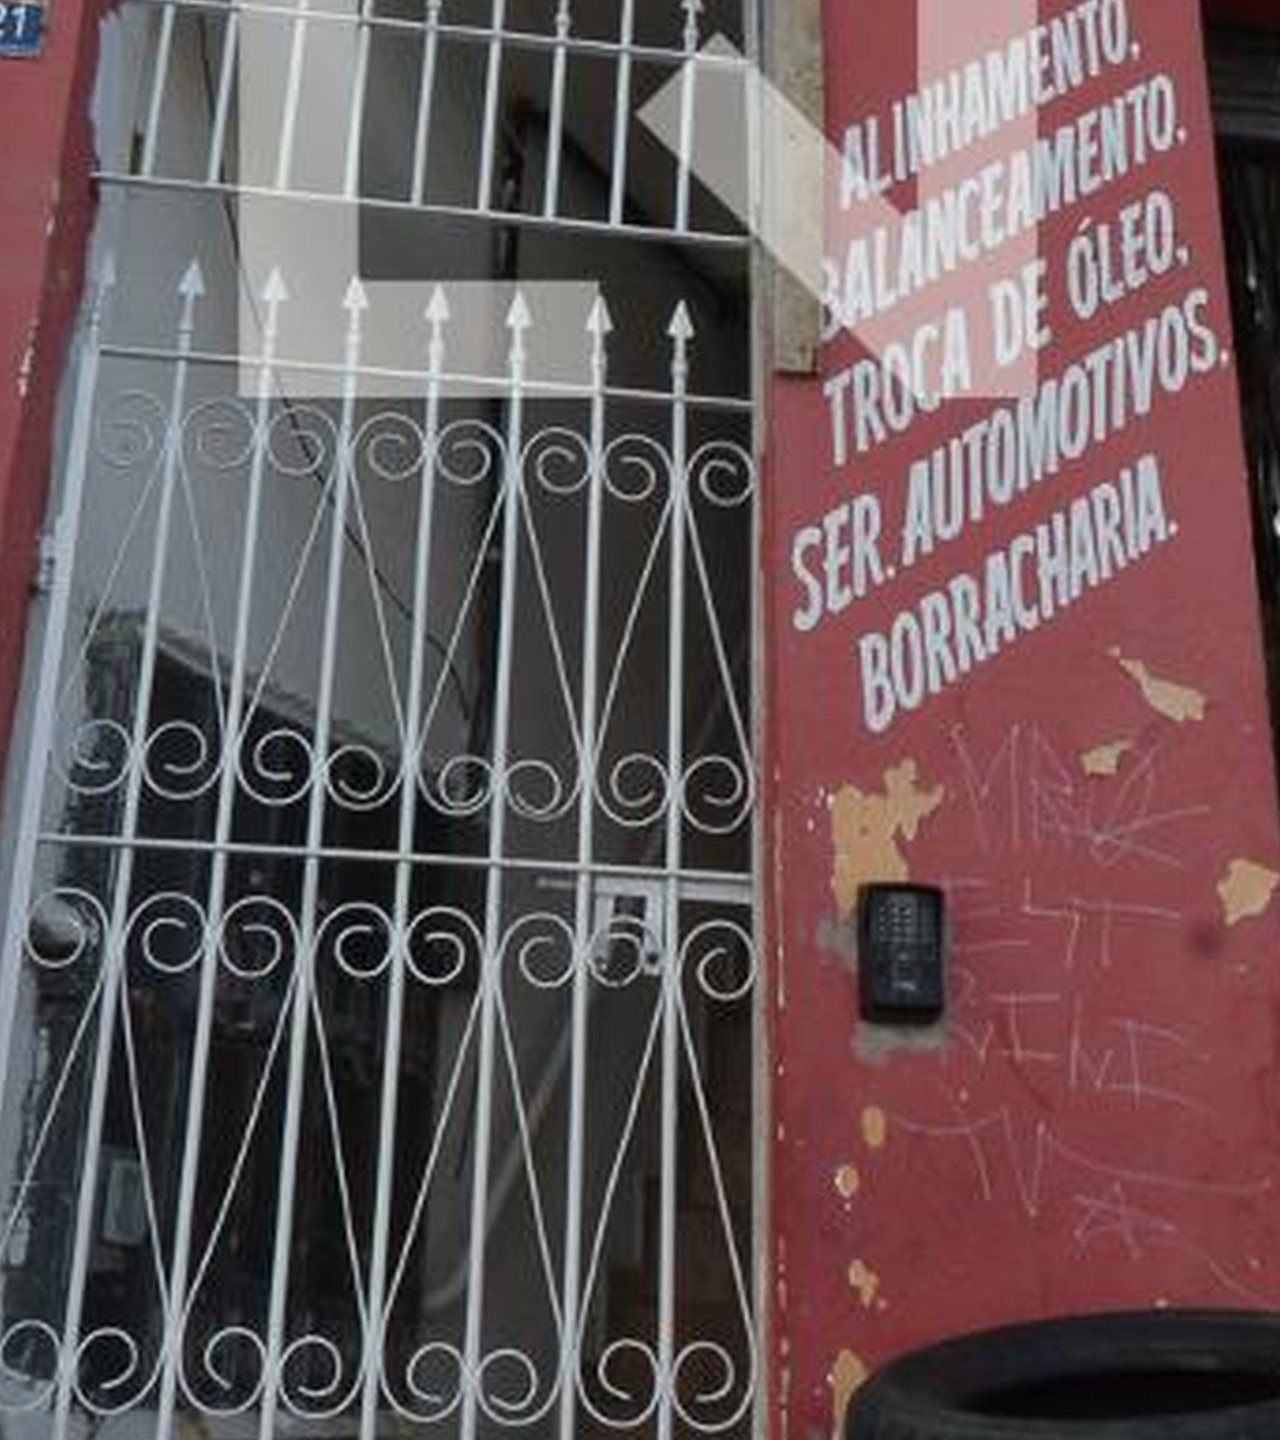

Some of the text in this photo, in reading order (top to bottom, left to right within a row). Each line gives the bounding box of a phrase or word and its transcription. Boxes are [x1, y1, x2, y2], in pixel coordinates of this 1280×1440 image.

[824, 307, 972, 466] TROCA
[989, 258, 1052, 367] DE
[791, 493, 896, 632] SER.
